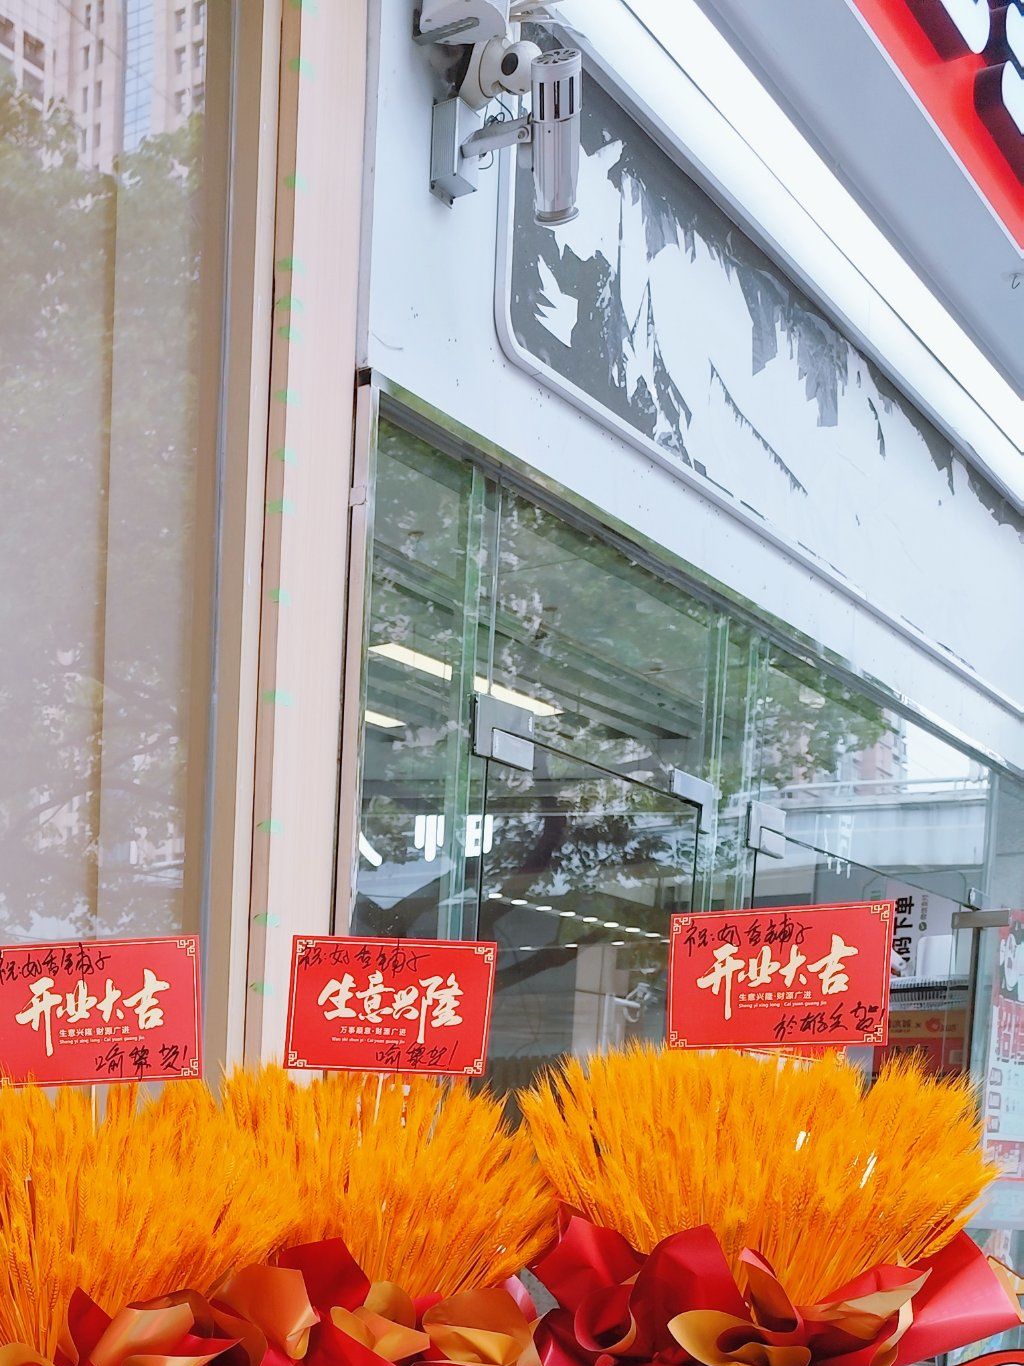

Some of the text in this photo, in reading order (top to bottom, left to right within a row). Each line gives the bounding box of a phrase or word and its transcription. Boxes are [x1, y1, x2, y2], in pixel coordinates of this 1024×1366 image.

[892, 895, 914, 962] 码下单
[317, 970, 464, 1044] 生意兴隆
[696, 934, 858, 1020] 开业大吉
[738, 991, 812, 1001] 生意兴隆·财源广进
[16, 969, 170, 1057] 开业大吉
[59, 1026, 130, 1037] 生意兴隆·财源广进
